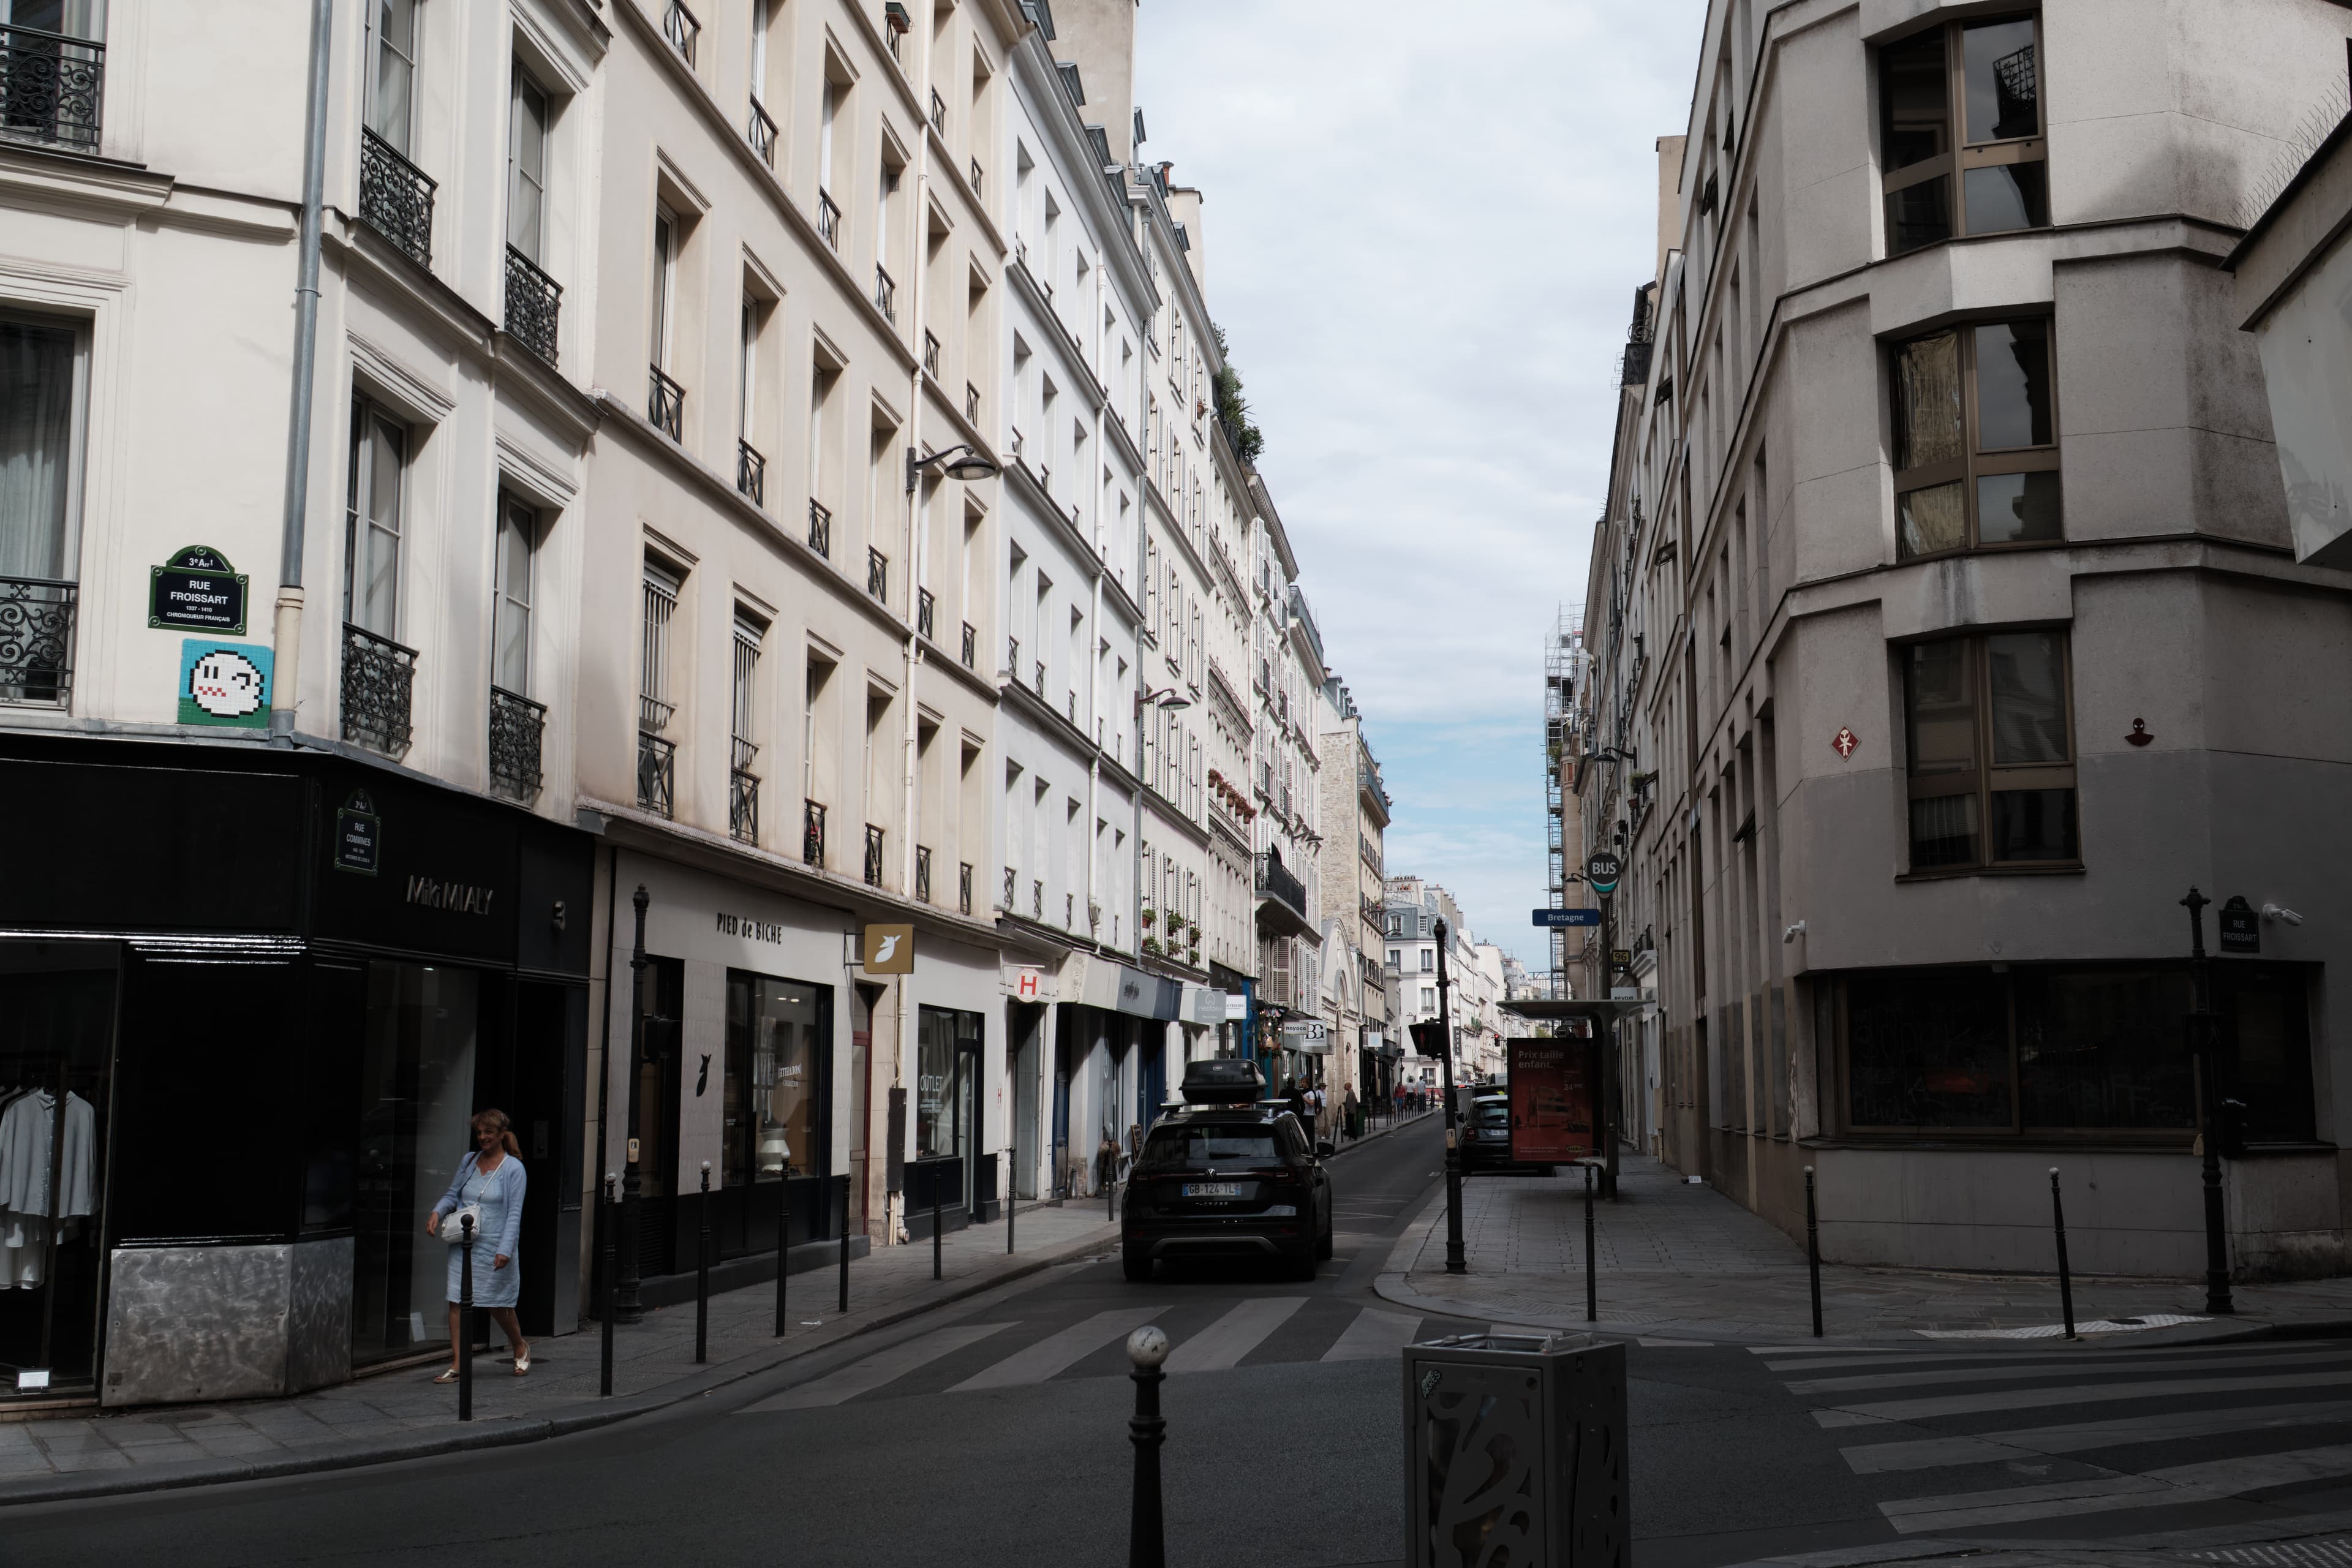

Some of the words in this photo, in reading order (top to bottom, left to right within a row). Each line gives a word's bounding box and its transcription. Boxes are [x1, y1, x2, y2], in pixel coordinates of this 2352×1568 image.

[189, 580, 211, 590] RUE
[170, 591, 228, 605] FROISSART
[167, 611, 204, 620] CHRONIQUEUR
[205, 614, 230, 623] FRANÇAIS
[355, 823, 365, 833] RUE
[346, 833, 371, 846] COMMINES
[1593, 862, 1616, 875] BUS
[407, 874, 440, 908] Miki
[442, 882, 494, 915] MIALY
[554, 900, 566, 931] 3
[1548, 914, 1584, 922] Bretagne
[717, 912, 737, 936] PIED
[742, 917, 752, 939] de
[756, 921, 782, 944] BICHE
[2233, 919, 2245, 929] RUE
[2223, 932, 2256, 941] FROISSART
[1615, 952, 1627, 961] 96
[1020, 975, 1037, 995] H
[1305, 1024, 1324, 1039] BG
[1518, 1050, 1538, 1059] Prix
[1540, 1050, 1564, 1059] taille
[1518, 1060, 1554, 1068] enfant.
[921, 1075, 943, 1092] OUTLET
[1189, 1184, 1234, 1194] GB-124-TL
